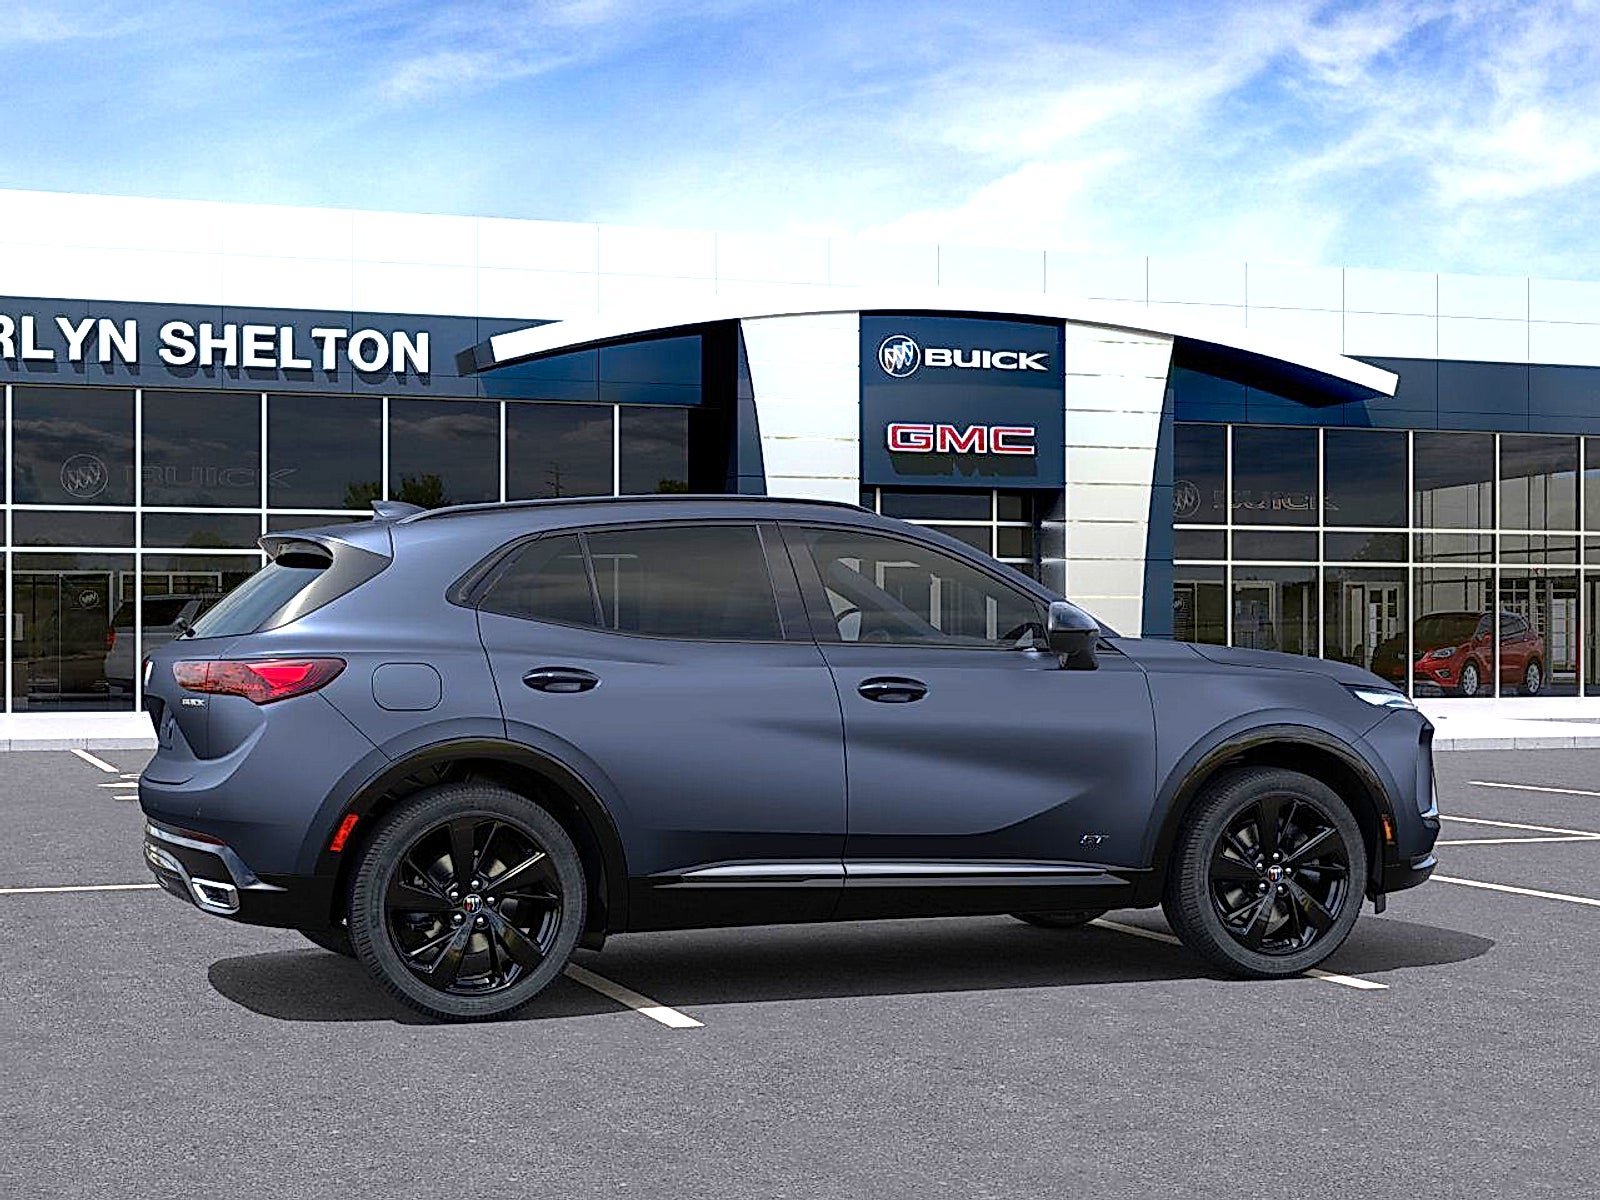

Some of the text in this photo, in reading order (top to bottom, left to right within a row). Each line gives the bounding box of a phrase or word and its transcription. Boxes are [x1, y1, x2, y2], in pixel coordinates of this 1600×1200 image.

[158, 320, 430, 374] SHELTON
[924, 348, 1049, 371] BUICK
[887, 423, 1035, 455] GMC
